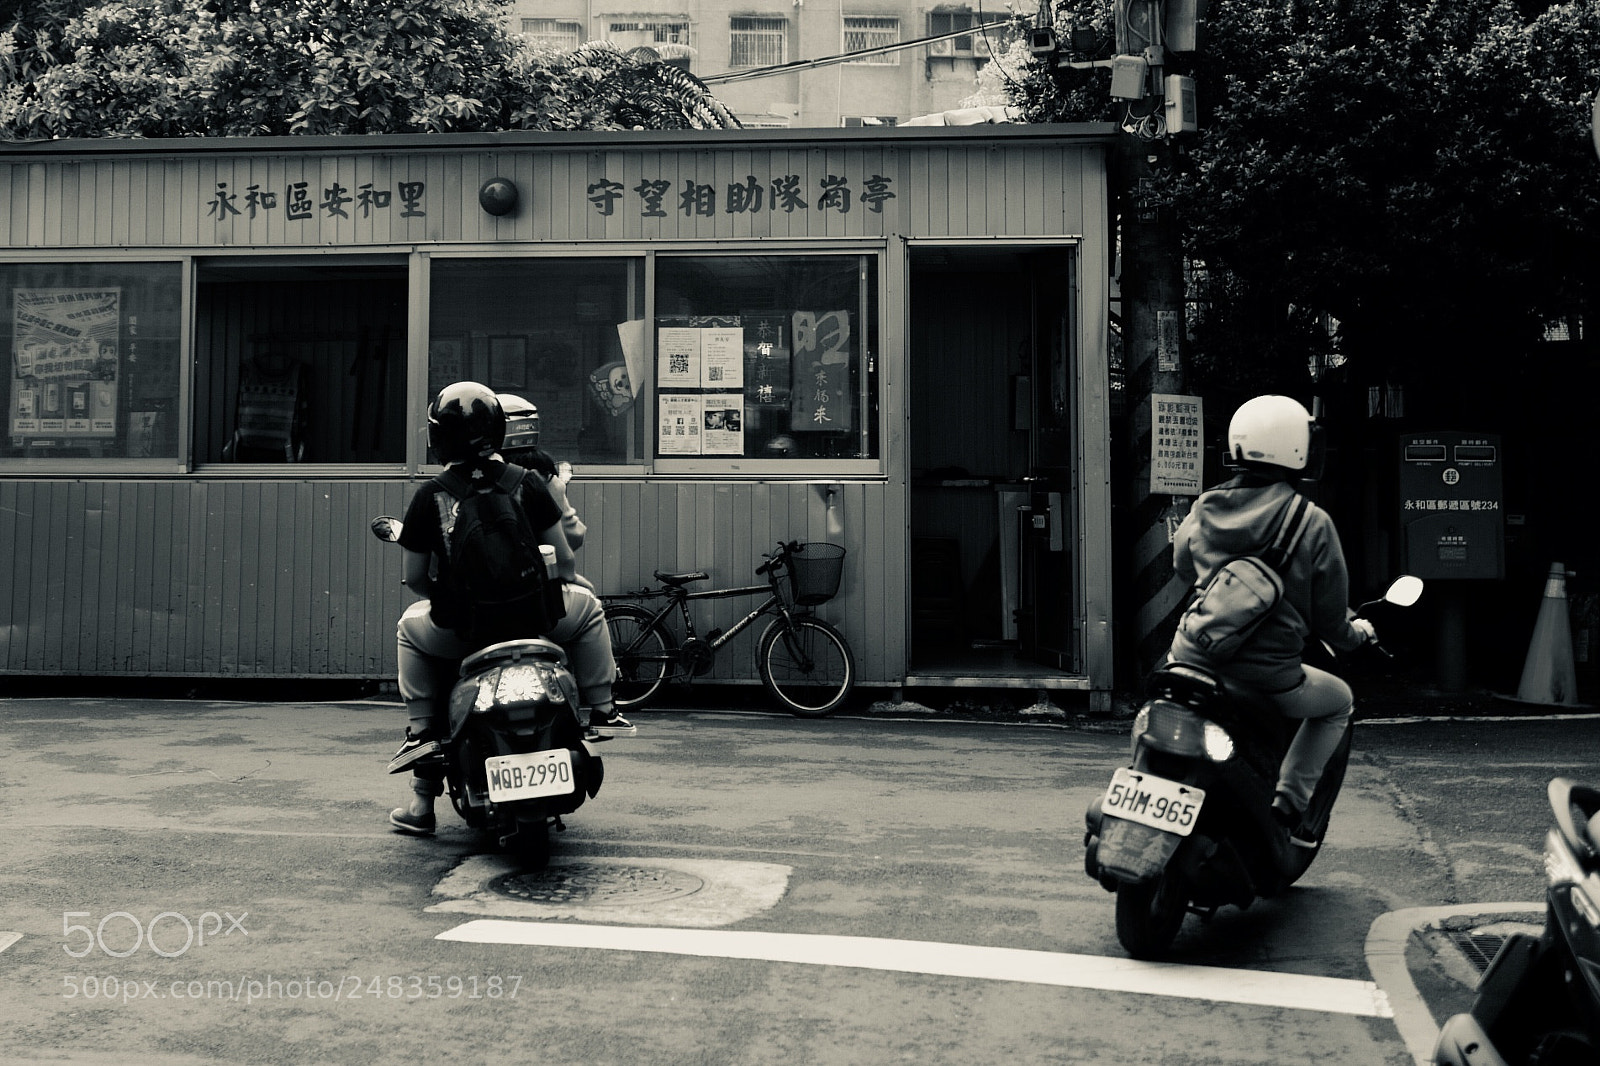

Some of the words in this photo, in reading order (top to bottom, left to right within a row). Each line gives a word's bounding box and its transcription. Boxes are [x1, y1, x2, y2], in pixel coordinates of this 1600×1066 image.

[207, 182, 426, 221] 永和區安和里
[587, 175, 896, 218] 守望相助隊崗亭
[1404, 499, 1499, 511] 永和區郵遞區號234
